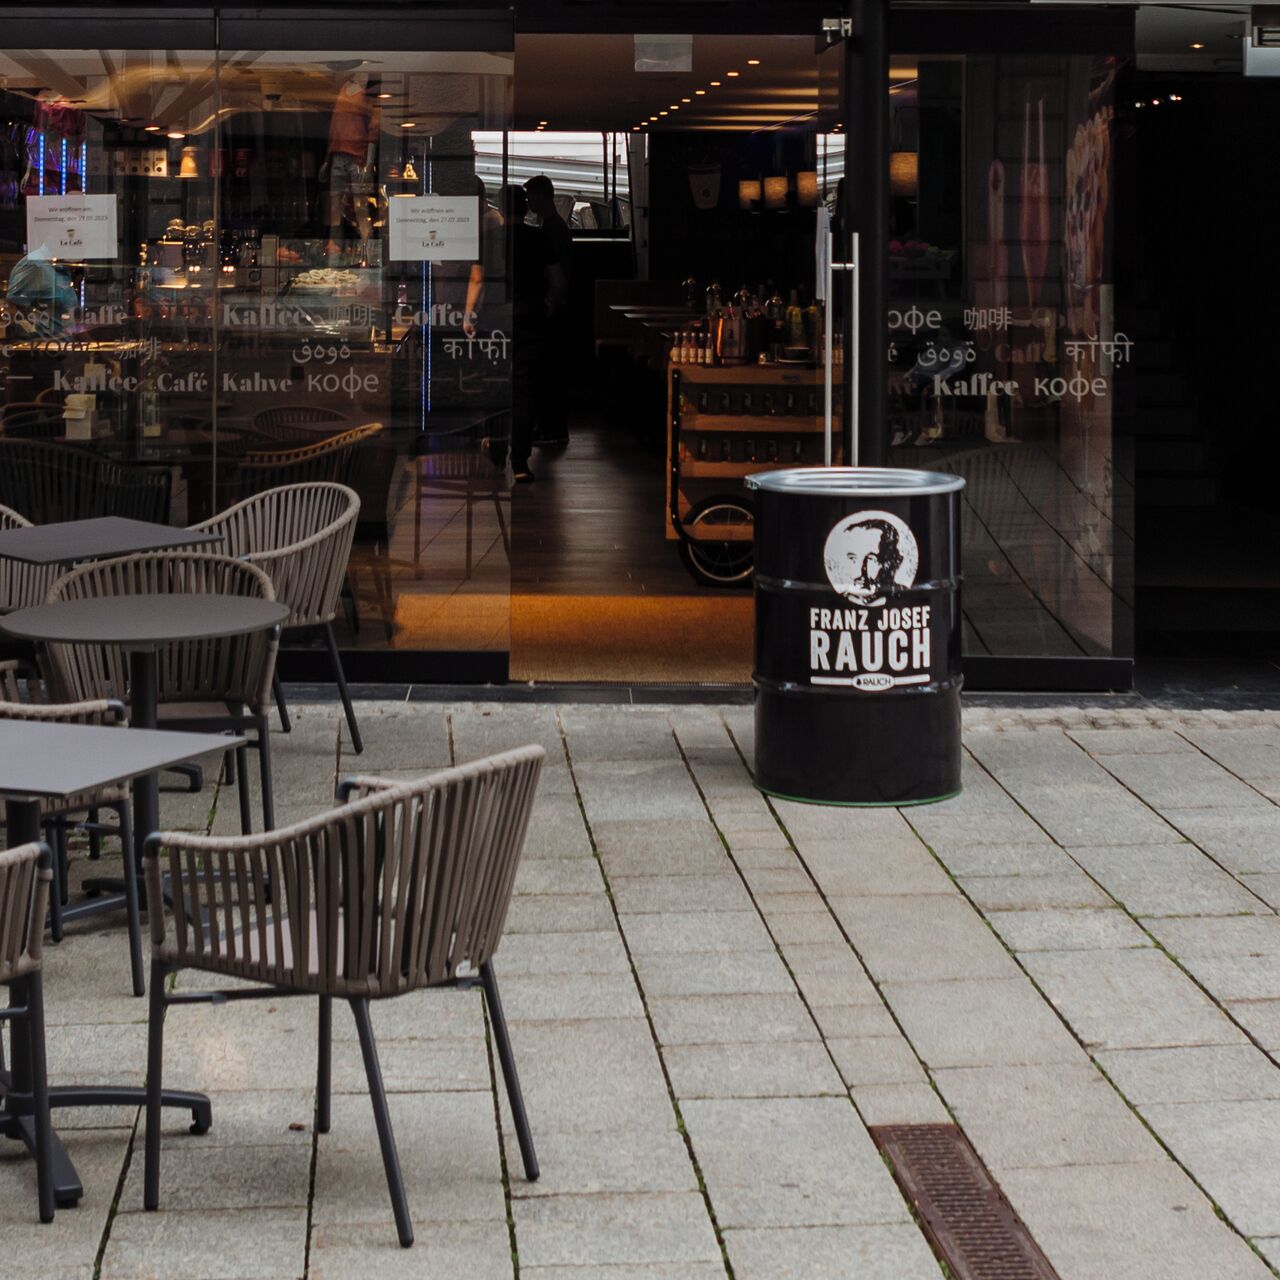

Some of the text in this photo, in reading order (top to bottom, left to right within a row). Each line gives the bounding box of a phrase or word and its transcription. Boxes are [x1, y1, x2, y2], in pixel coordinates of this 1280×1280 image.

[223, 304, 307, 326] Kaffee
[396, 303, 479, 327] Coffee
[53, 369, 137, 392] Kaffee
[157, 371, 209, 392] Café
[222, 371, 294, 393] Kahve
[307, 366, 380, 399] кофе
[933, 372, 1020, 397] Kaffee
[1034, 370, 1108, 402] кофе
[810, 605, 931, 630] FRANZ JOSEF
[810, 628, 931, 672] RAUCH
[862, 676, 891, 687] RAUCH
